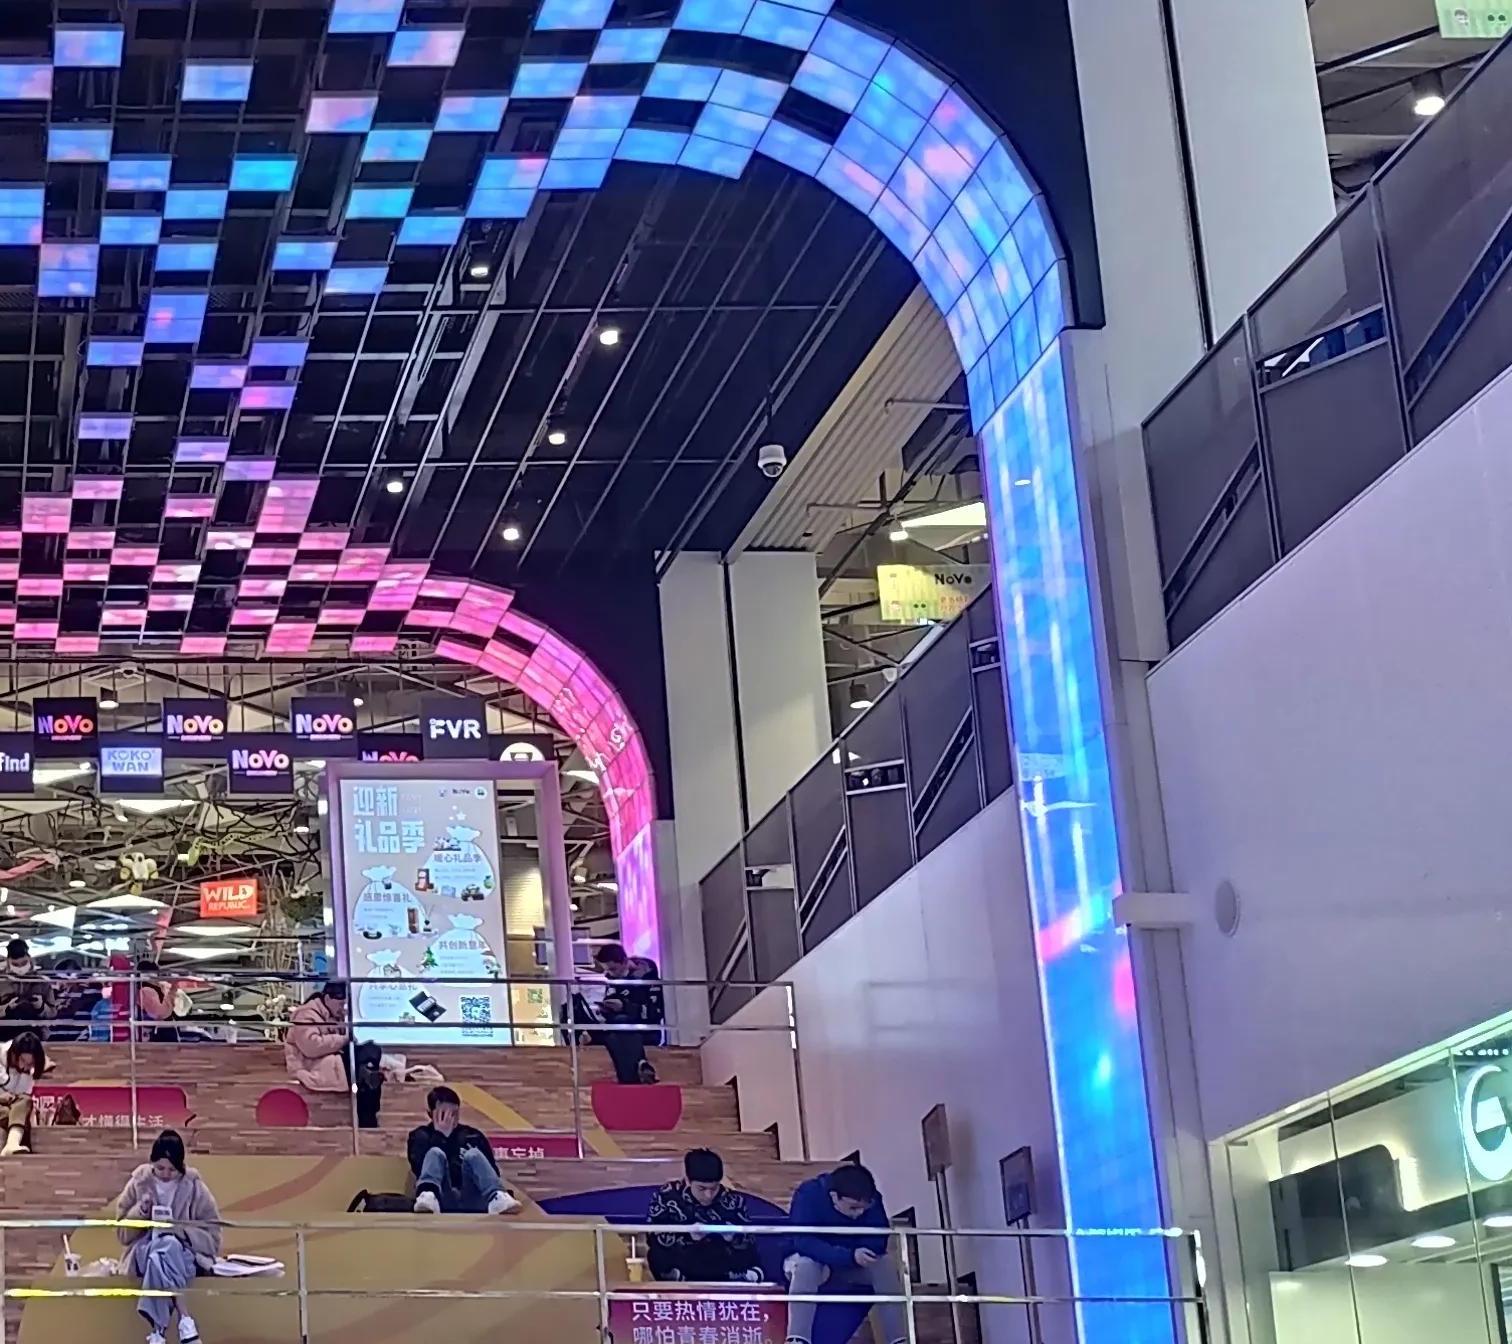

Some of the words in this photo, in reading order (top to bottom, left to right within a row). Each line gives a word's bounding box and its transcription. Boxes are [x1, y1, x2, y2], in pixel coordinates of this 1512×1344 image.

[38, 714, 94, 734] NoVo
[167, 714, 224, 734] NoVo
[295, 713, 354, 734] NoVo
[112, 761, 149, 772] WAN
[231, 749, 289, 769] NoVo
[353, 786, 398, 816] 迎新
[354, 819, 425, 853] 礼品季
[204, 885, 254, 902] WILD
[632, 1301, 770, 1322] 只要热情犹在，
